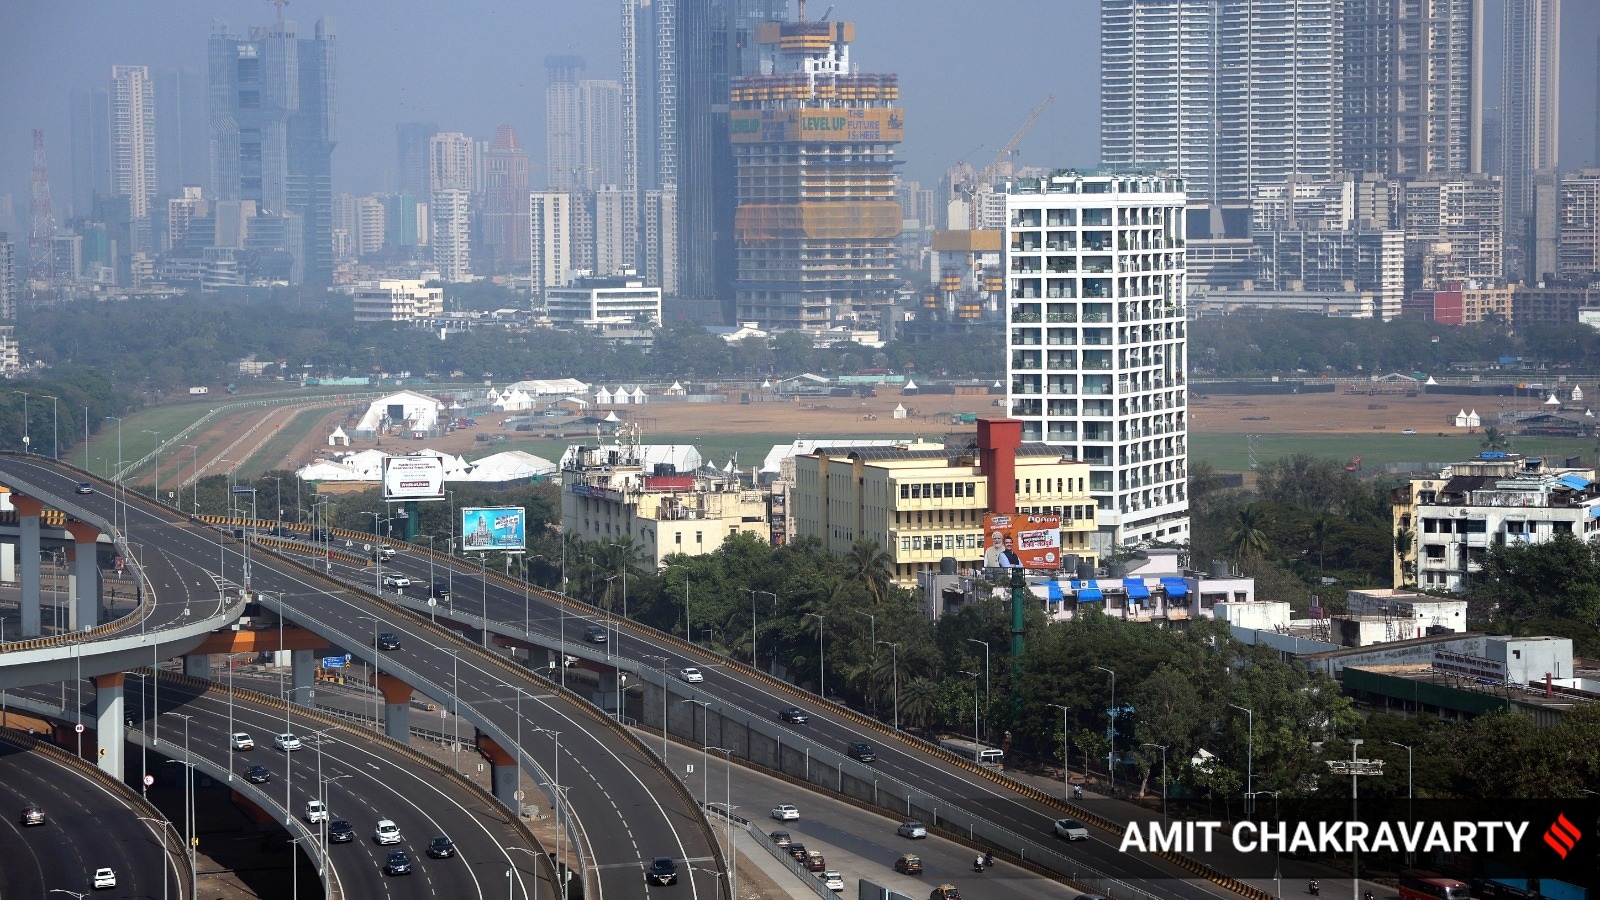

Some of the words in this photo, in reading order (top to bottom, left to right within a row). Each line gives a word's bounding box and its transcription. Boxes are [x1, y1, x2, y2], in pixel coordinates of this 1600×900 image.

[848, 110, 864, 118] THE
[802, 117, 830, 130] LEVEL
[833, 117, 846, 130] UP
[848, 121, 880, 129] FUTURE
[848, 131, 857, 139] IS
[860, 131, 880, 139] HERE
